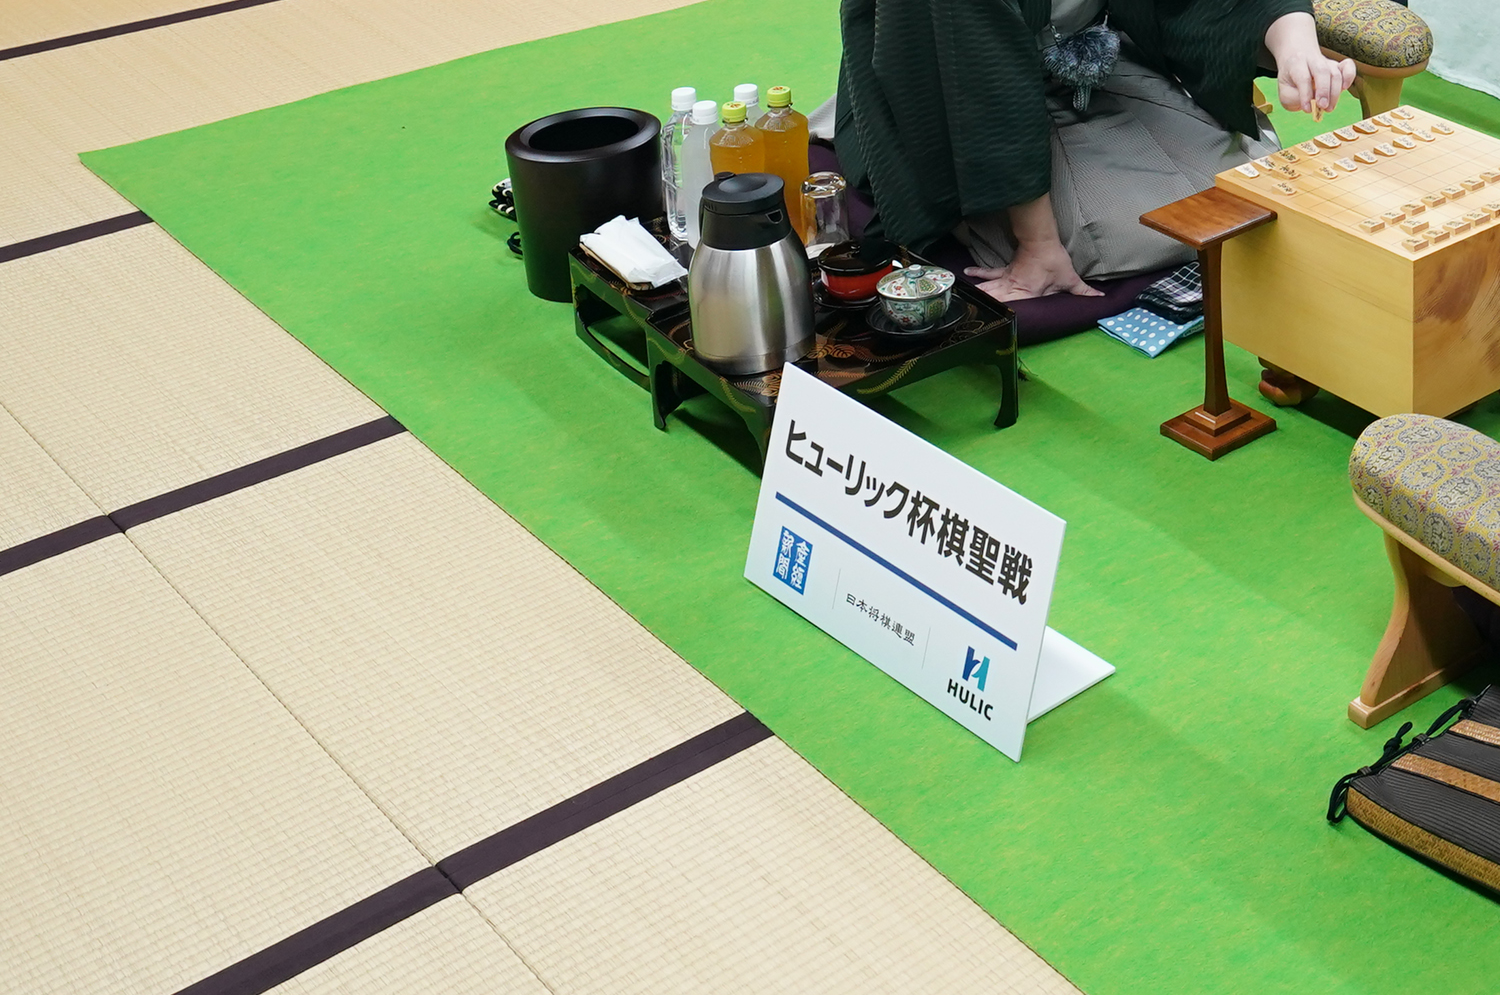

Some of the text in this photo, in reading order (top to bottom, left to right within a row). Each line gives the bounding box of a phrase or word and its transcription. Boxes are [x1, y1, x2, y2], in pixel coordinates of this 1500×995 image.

[785, 418, 1034, 606] ヒューリック杯棋聖戦
[845, 593, 916, 647] 日本将棋連盟
[946, 678, 995, 722] HULIC
